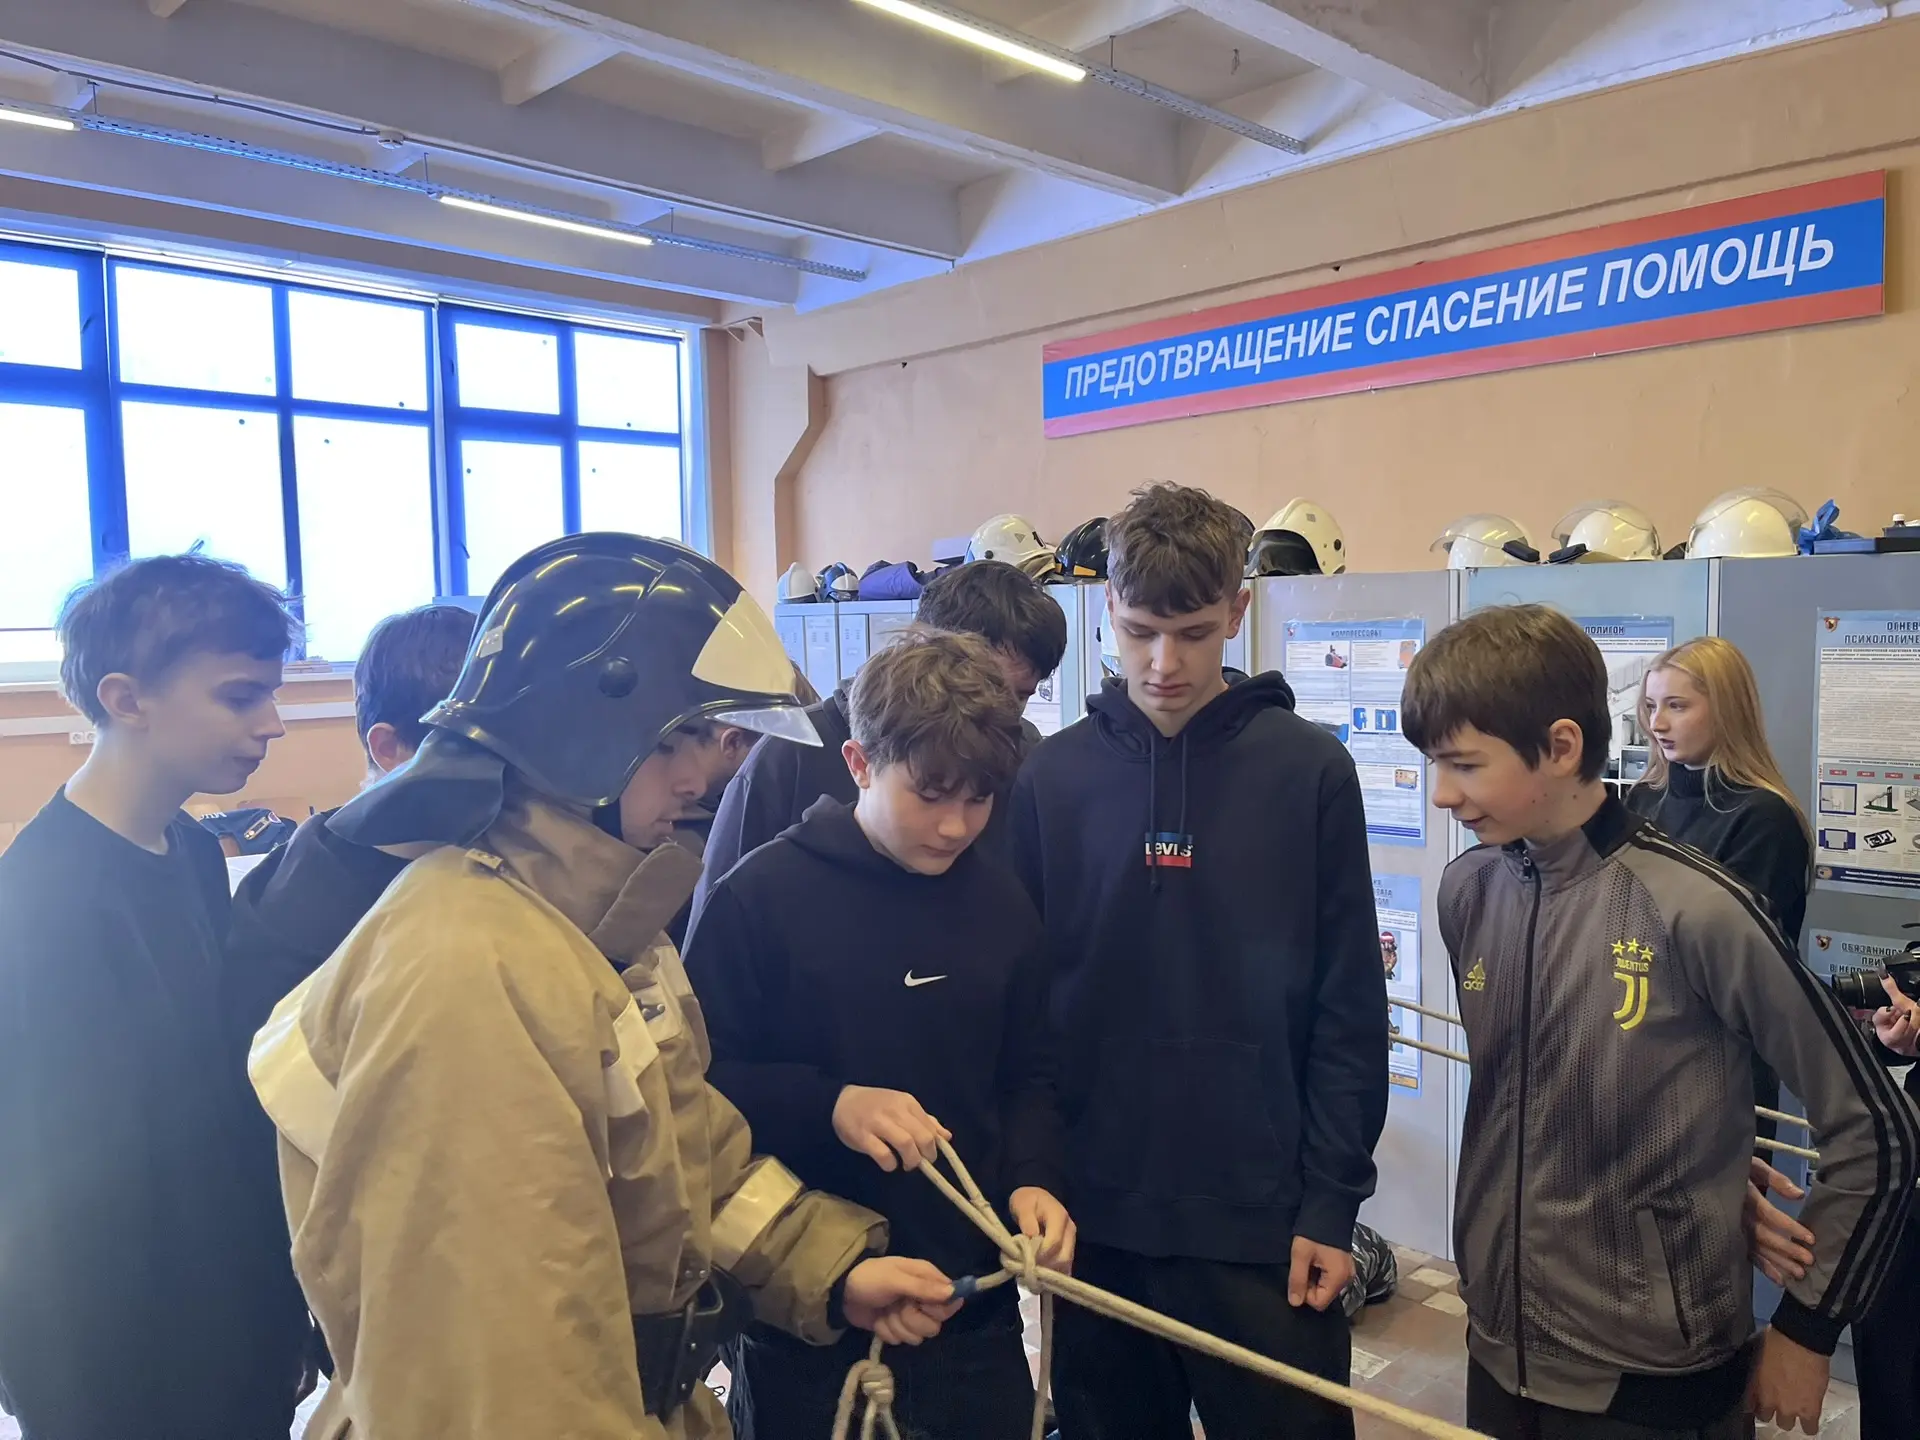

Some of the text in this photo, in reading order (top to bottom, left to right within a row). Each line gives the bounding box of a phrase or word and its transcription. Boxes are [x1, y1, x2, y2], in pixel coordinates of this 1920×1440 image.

[1064, 224, 1835, 399] ПРЕДОТВРАЩЕНИЕ СПАСЕНИЕ ПОМОЩЬ
[1886, 621, 1920, 631] ОГНЕВ
[1841, 942, 1903, 956] ОБЯЗАННОС
[1615, 957, 1649, 973] JUVENTUS
